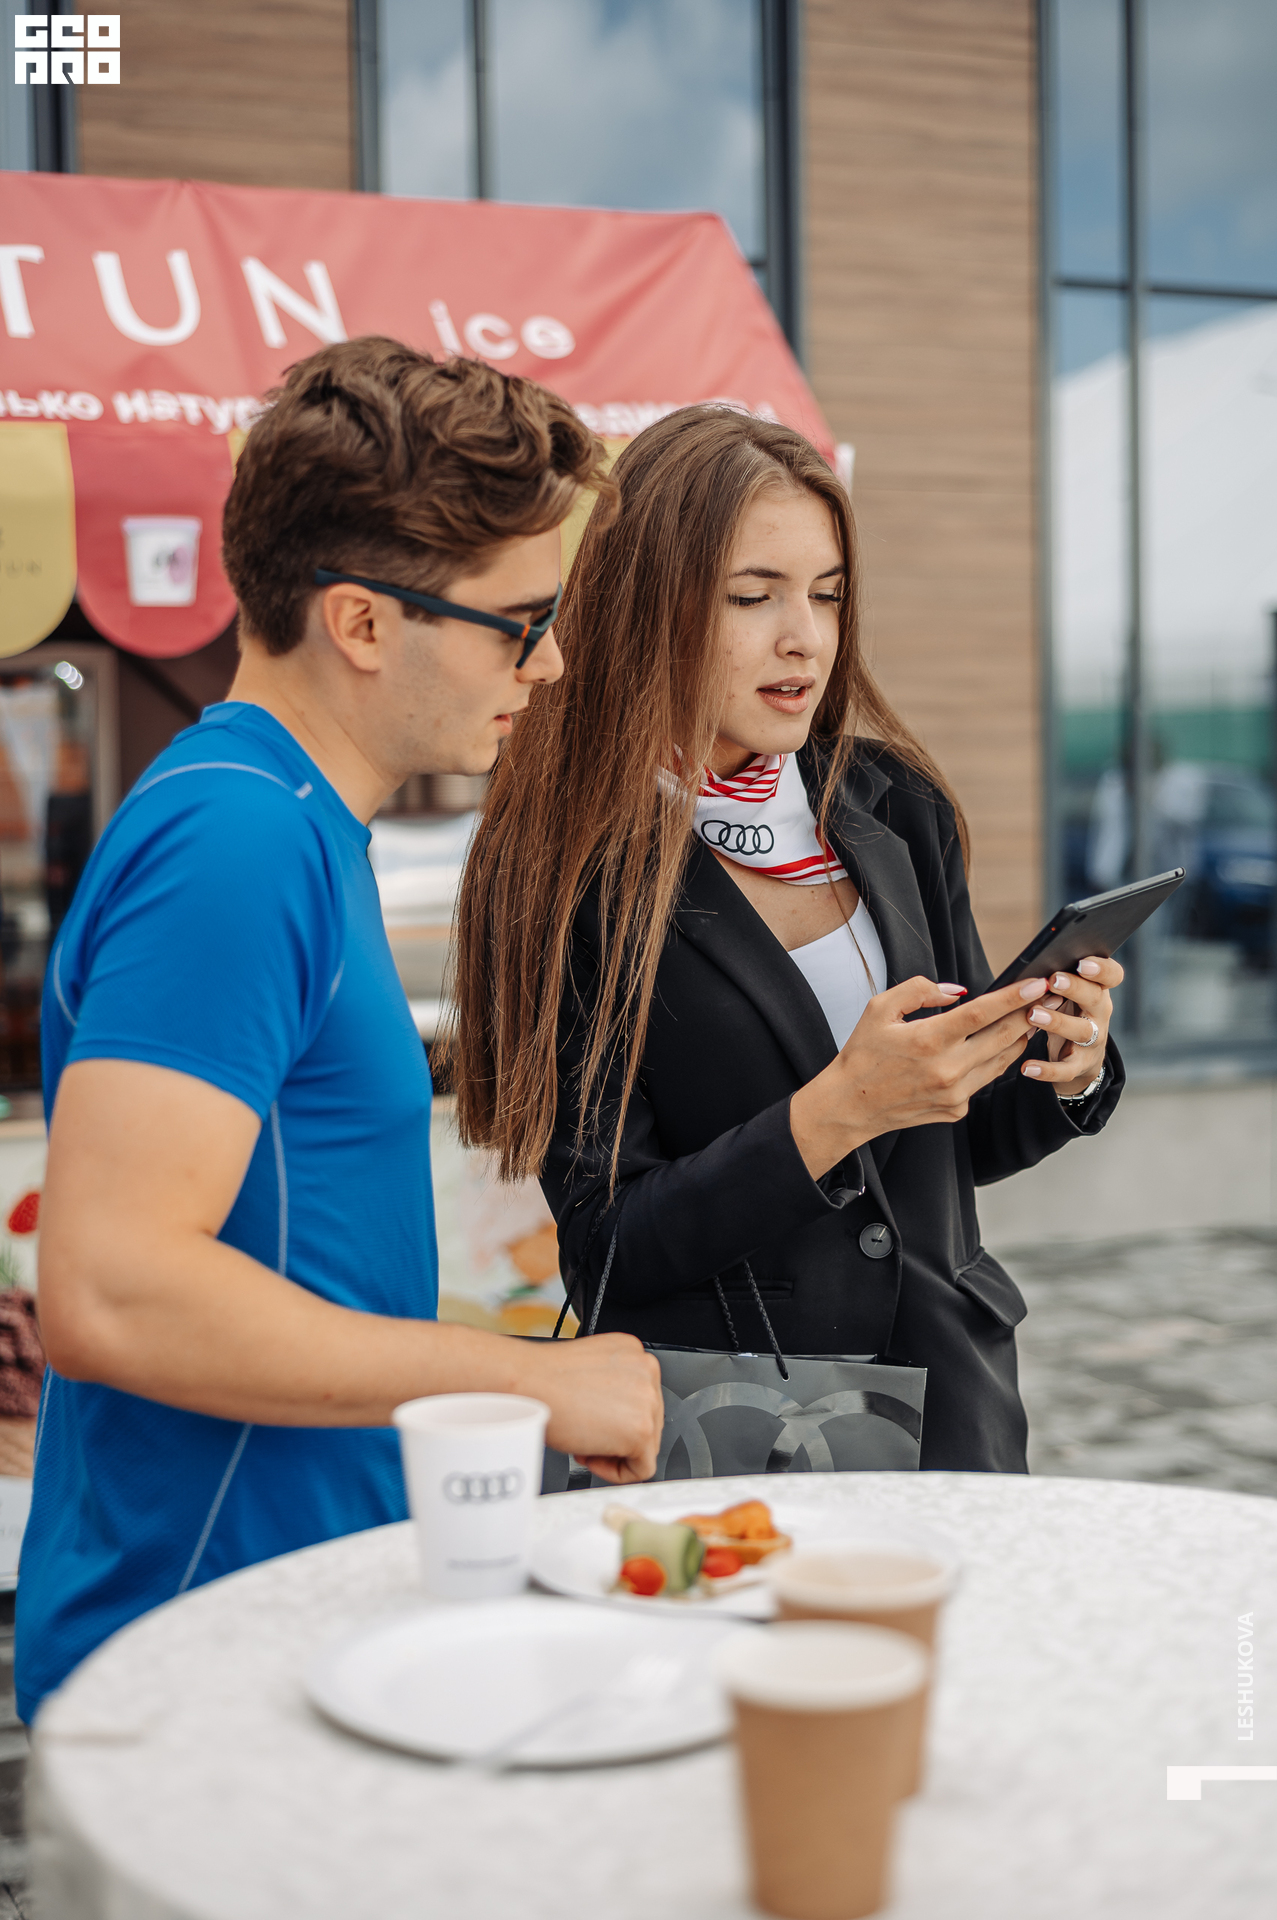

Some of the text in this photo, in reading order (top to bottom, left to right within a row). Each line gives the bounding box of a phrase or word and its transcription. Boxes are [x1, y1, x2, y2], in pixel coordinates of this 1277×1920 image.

[428, 299, 576, 360] ice
[0, 389, 274, 434] ько натур
